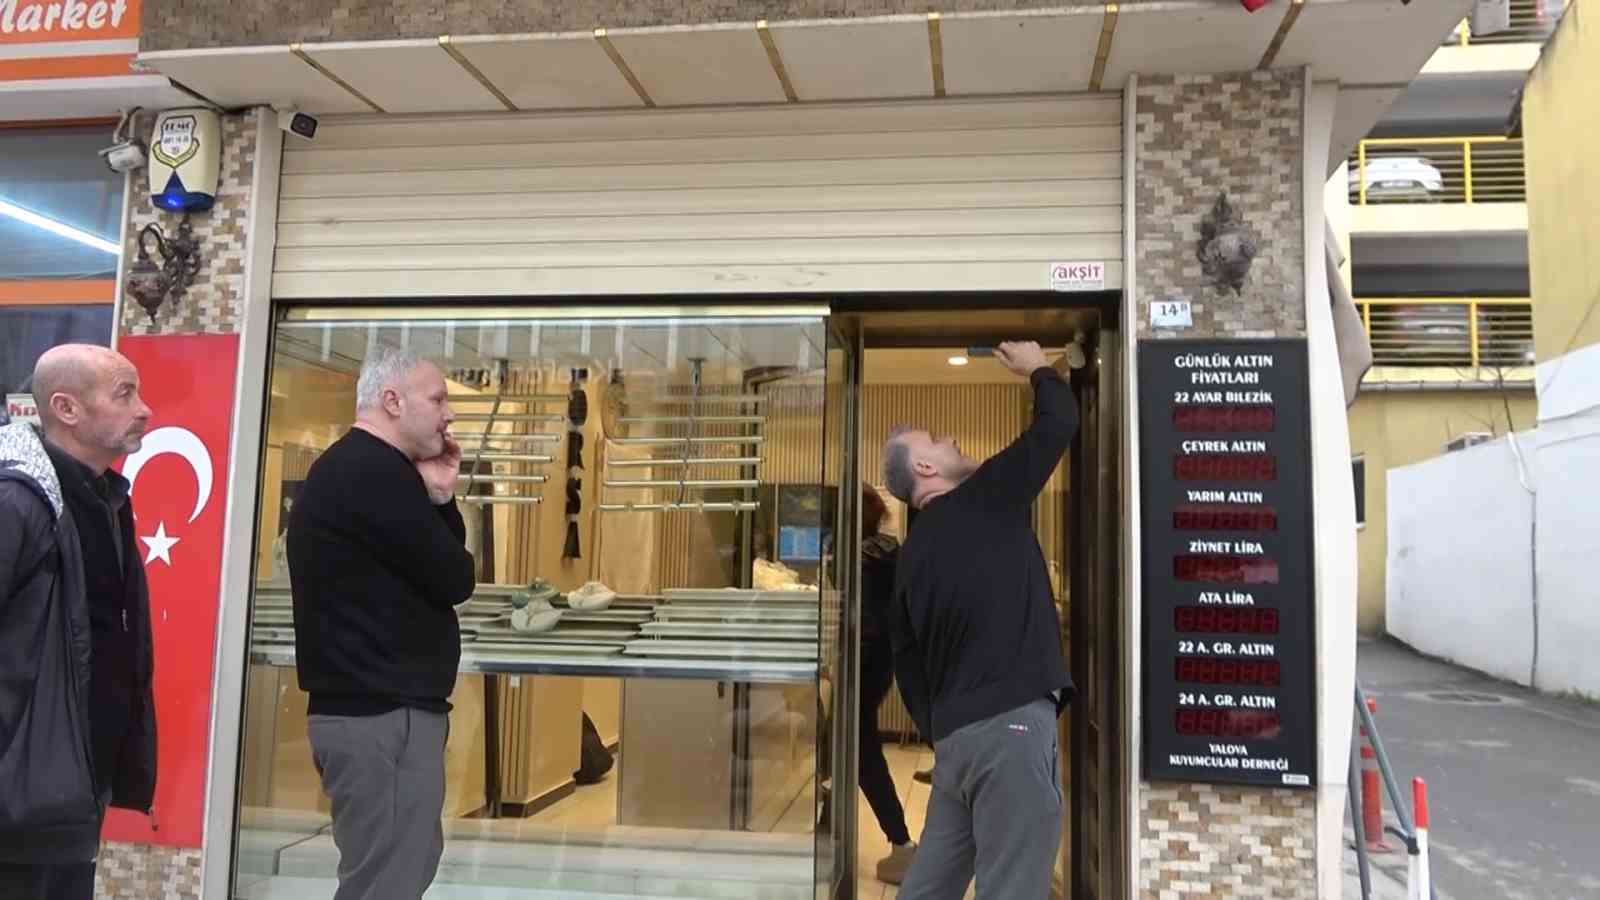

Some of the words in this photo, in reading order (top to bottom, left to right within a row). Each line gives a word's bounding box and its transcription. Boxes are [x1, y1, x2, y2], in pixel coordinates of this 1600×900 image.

[1174, 353, 1231, 368] GÜNLÜK
[1234, 355, 1273, 368] ALTIN
[1191, 369, 1260, 384] FİYATLARI
[1174, 391, 1189, 403] 22
[1192, 391, 1222, 403] AYAR
[1182, 440, 1229, 455] ÇEYREK
[1231, 440, 1266, 452] ALTIN
[1187, 490, 1225, 502] YARIM
[1227, 491, 1263, 503] ALTIN
[1189, 539, 1231, 553] ZİYNET
[1234, 540, 1264, 554] LİRA
[1199, 591, 1222, 604] ATA
[1225, 589, 1255, 605] LİRA
[1178, 641, 1194, 653] 22
[1196, 642, 1210, 654] A.
[1212, 642, 1236, 655] GR.
[1239, 643, 1275, 656] ALTIN
[1178, 692, 1195, 705] 24
[1198, 693, 1211, 706] A.
[1214, 694, 1237, 707] GR.
[1240, 695, 1276, 708] ALTIN
[1208, 743, 1249, 756] YALOVA
[1169, 755, 1239, 769] KUYUMCULAR
[1241, 757, 1289, 771] DERNEĞİ
